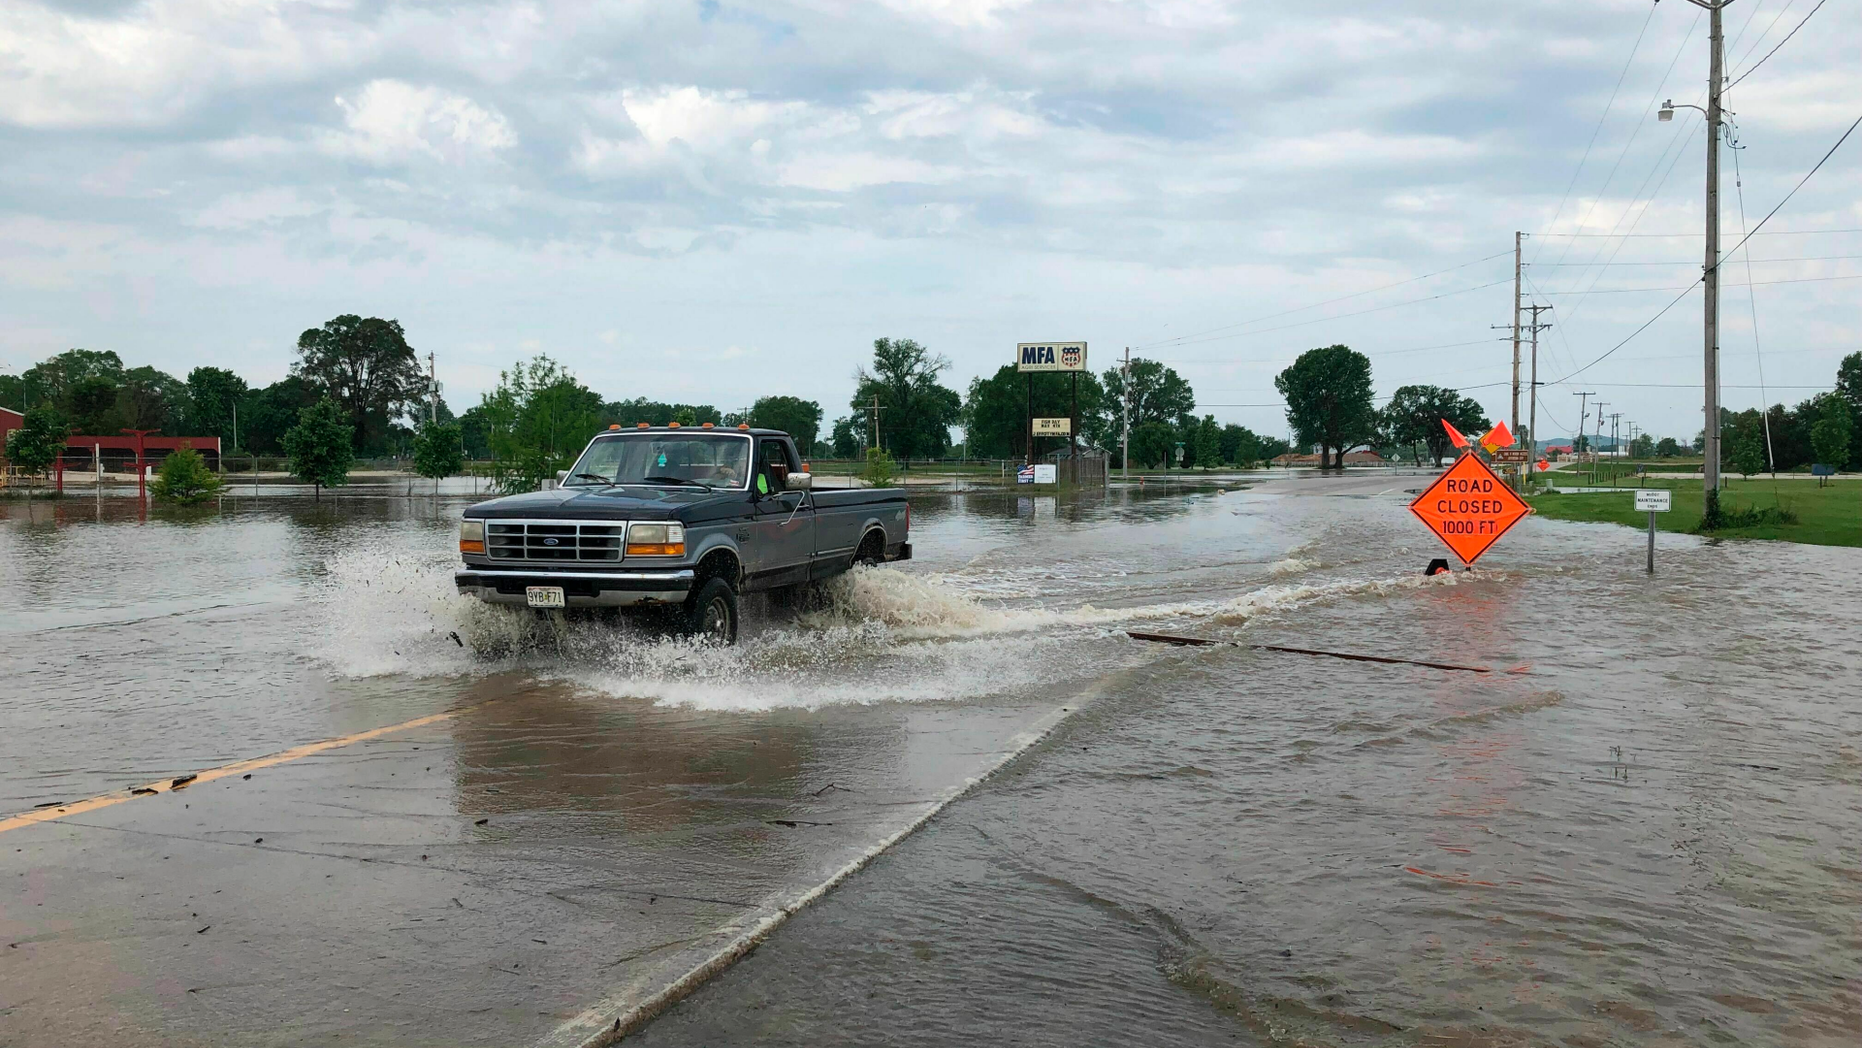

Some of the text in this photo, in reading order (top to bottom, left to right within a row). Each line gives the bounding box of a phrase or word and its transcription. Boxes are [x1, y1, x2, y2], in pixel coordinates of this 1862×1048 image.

[1022, 347, 1055, 364] MFA
[1447, 480, 1493, 493] ROAD
[1437, 500, 1503, 514] CLOSED
[1443, 521, 1496, 534] 1000 FT
[547, 592, 562, 602] F71
